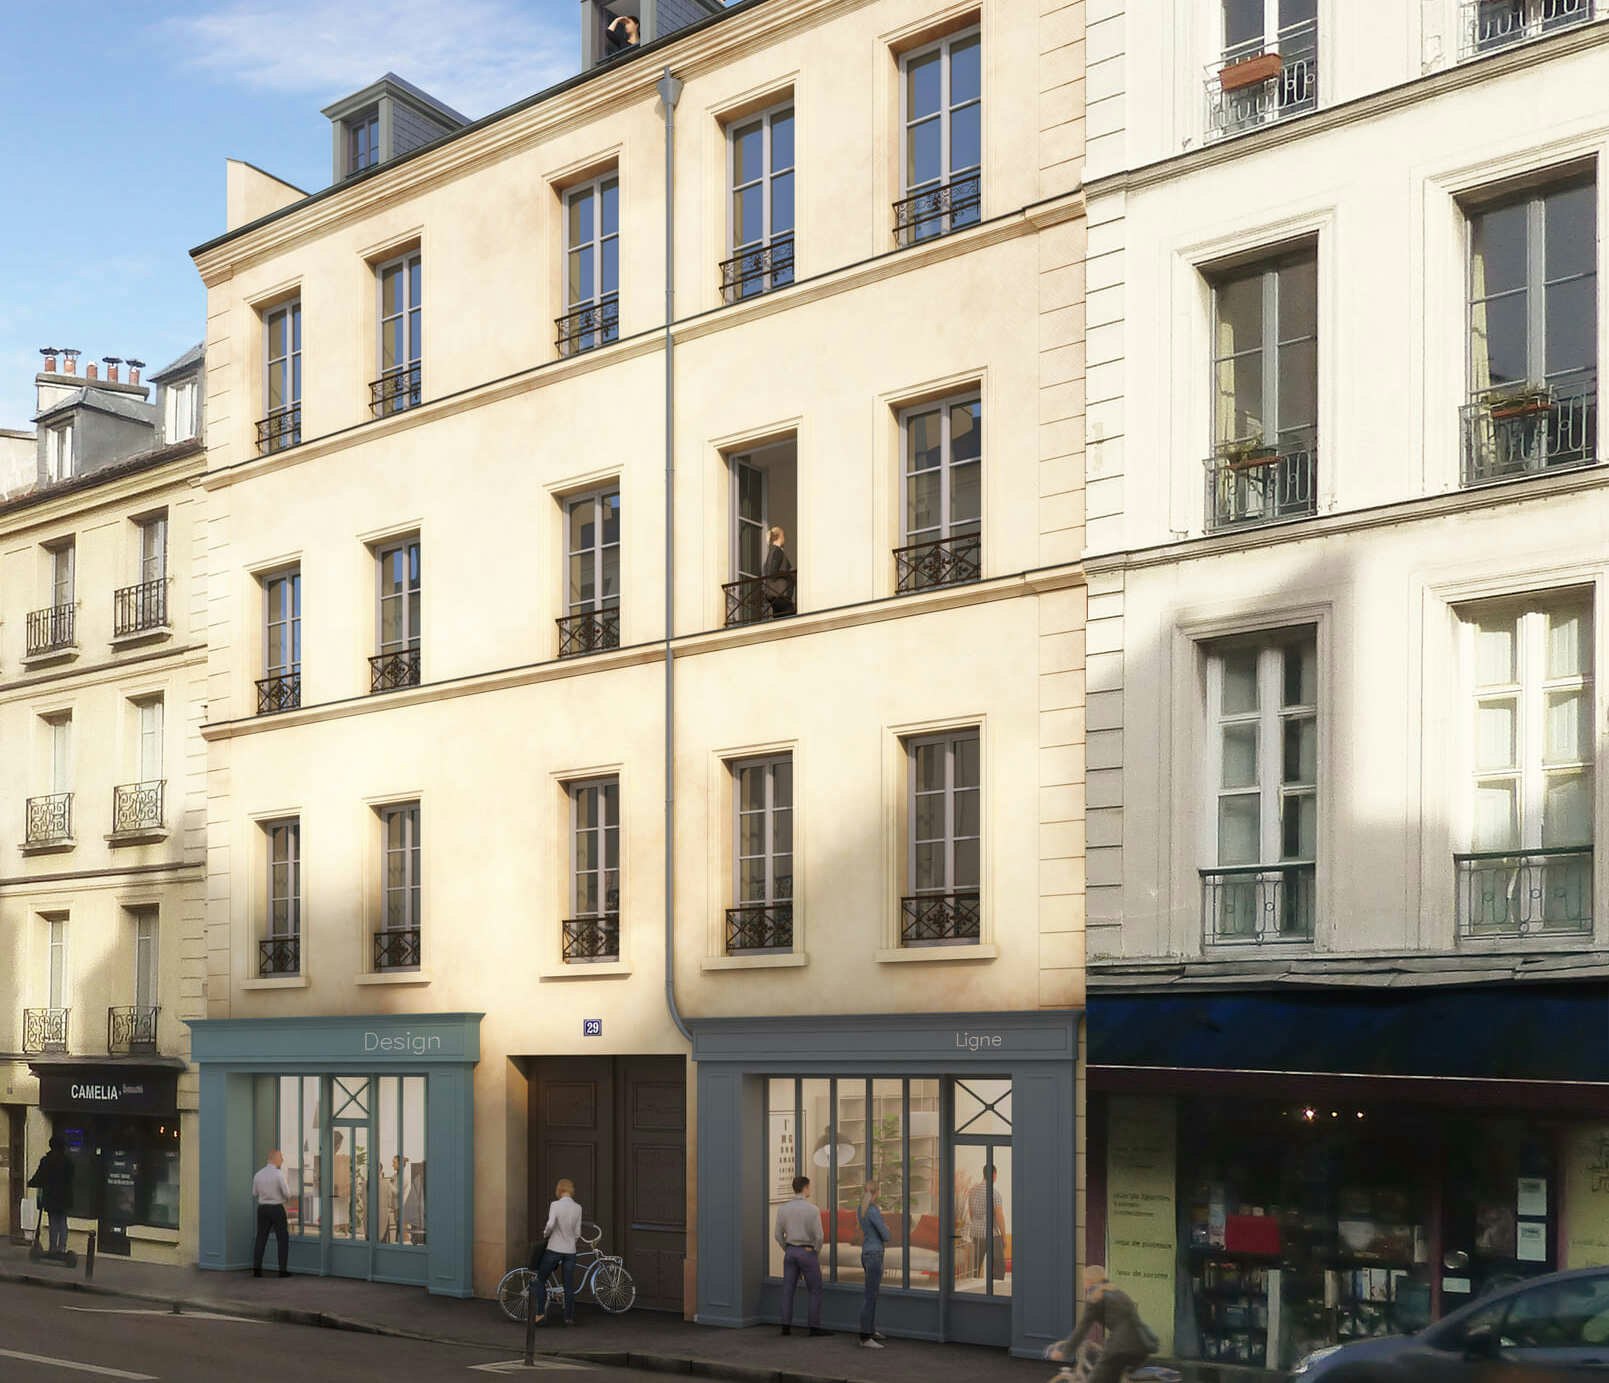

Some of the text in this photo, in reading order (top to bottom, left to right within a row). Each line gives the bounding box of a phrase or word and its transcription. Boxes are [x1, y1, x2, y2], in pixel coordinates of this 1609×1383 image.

[586, 1022, 599, 1034] 29
[364, 1031, 441, 1055] Design
[955, 1032, 1002, 1052] Ligne
[71, 1084, 118, 1100] CAMELIA
